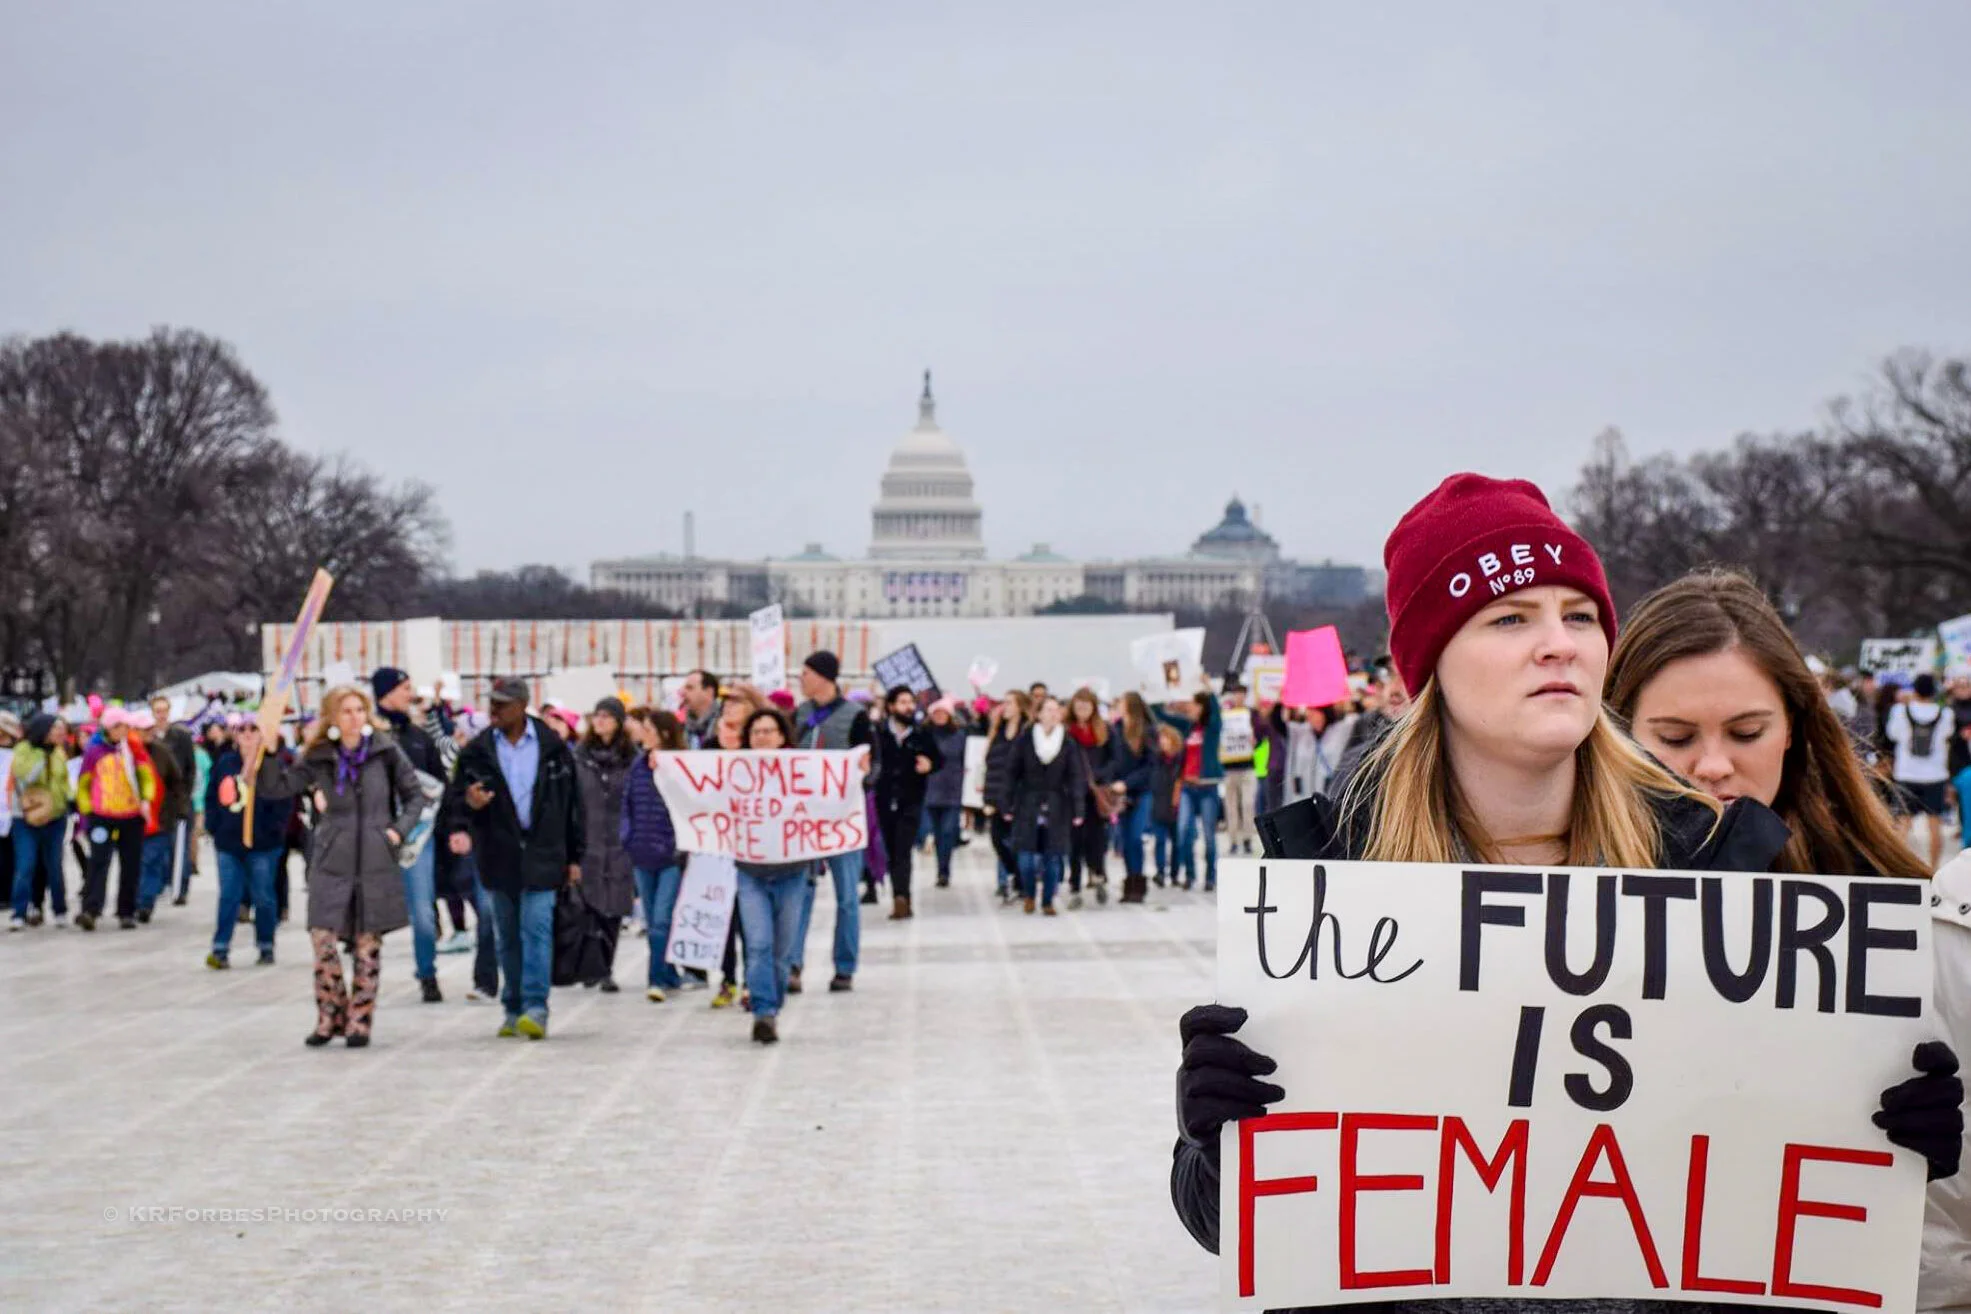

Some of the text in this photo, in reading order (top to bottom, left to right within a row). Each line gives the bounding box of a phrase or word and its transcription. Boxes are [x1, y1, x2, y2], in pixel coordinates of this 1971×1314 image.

[1449, 543, 1562, 598] OBEY
[674, 755, 849, 799] WOMEN
[688, 811, 864, 860] FREE PRESS
[730, 798, 809, 818] NEED A
[1244, 865, 1922, 1018] the FUTURE
[1508, 1004, 1634, 1112] IS
[1238, 1112, 1895, 1308] FEMALE
